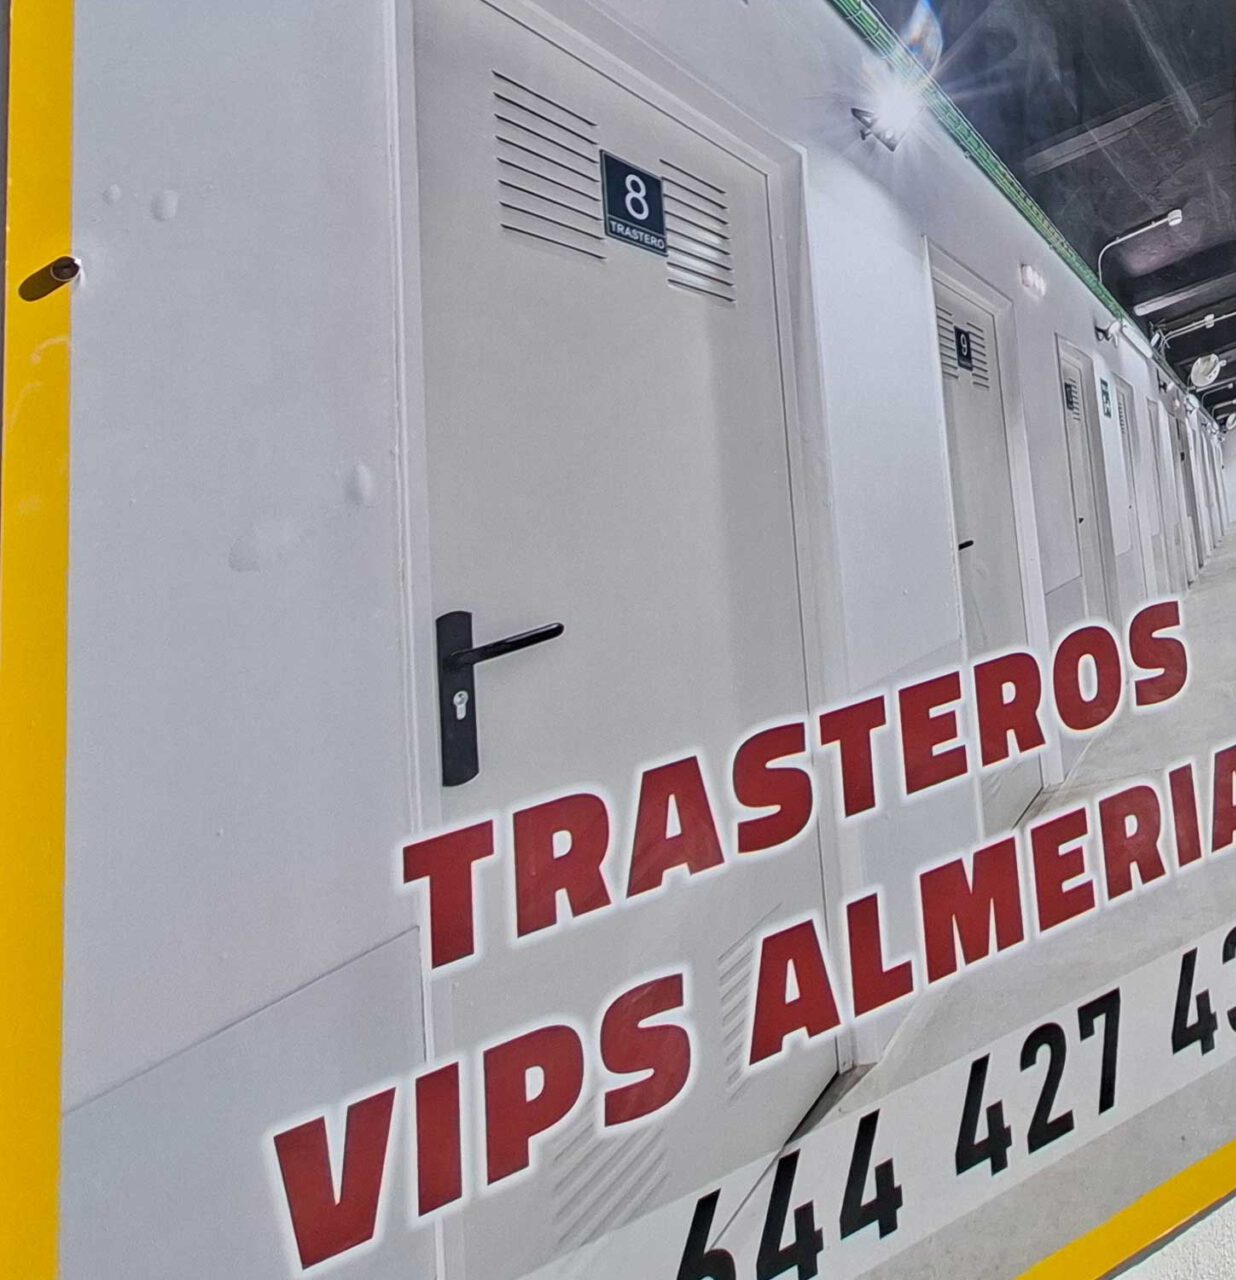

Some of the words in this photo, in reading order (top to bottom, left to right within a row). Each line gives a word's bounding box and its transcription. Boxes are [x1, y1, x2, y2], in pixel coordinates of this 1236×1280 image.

[609, 221, 666, 250] TRASTERO
[625, 174, 650, 220] 8
[403, 600, 1188, 969] TRASTEROS
[272, 974, 692, 1271] VIPS
[676, 1107, 904, 1280] 644
[954, 990, 1121, 1176] 427
